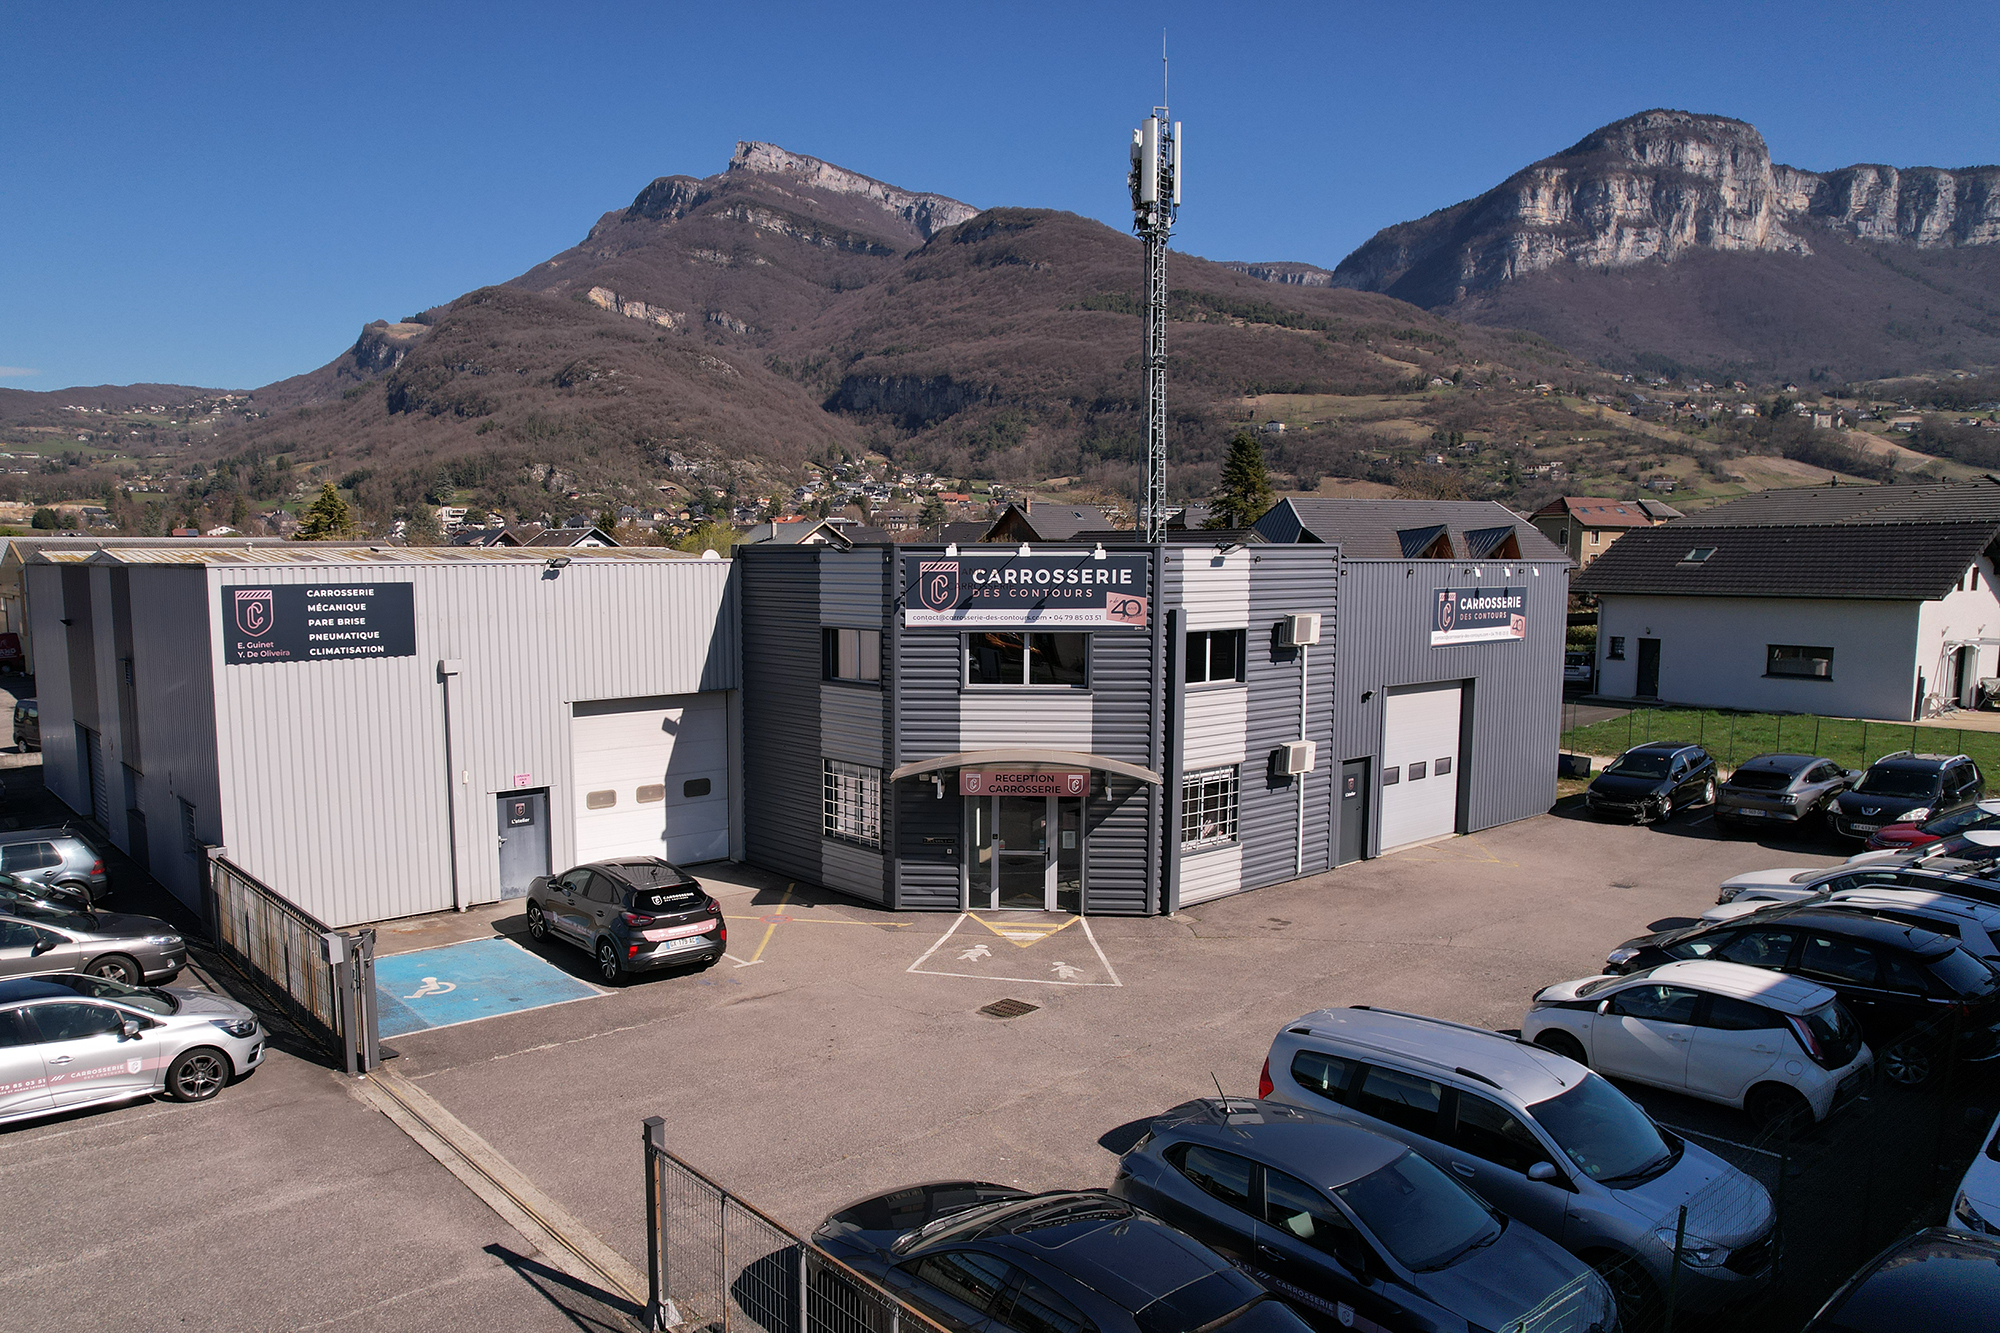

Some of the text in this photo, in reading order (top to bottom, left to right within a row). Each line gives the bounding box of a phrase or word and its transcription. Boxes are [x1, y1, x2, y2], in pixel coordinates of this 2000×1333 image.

[972, 569, 1132, 584] CARROSSERIE
[307, 589, 375, 598] CARROSSERIE
[972, 589, 1093, 597] DES CONTOURS
[308, 602, 366, 612] MÉCANIQUE
[1111, 599, 1142, 617] 40
[1460, 597, 1521, 610] CARROSSERIE
[1474, 612, 1506, 620] CONTOURS
[308, 617, 366, 627] PARE BRISE
[1512, 618, 1523, 631] 40
[309, 631, 380, 641] PNEUMATIQUE
[247, 641, 274, 649] Guinet
[260, 650, 290, 658] Oliveira
[309, 646, 384, 656] CLIMATISATION
[996, 774, 1054, 782] RECEPTION
[988, 785, 1061, 793] CARROSSERIE
[70, 1064, 124, 1078] CARROSSERIE
[1275, 1279, 1334, 1310] CARROSSERIE
